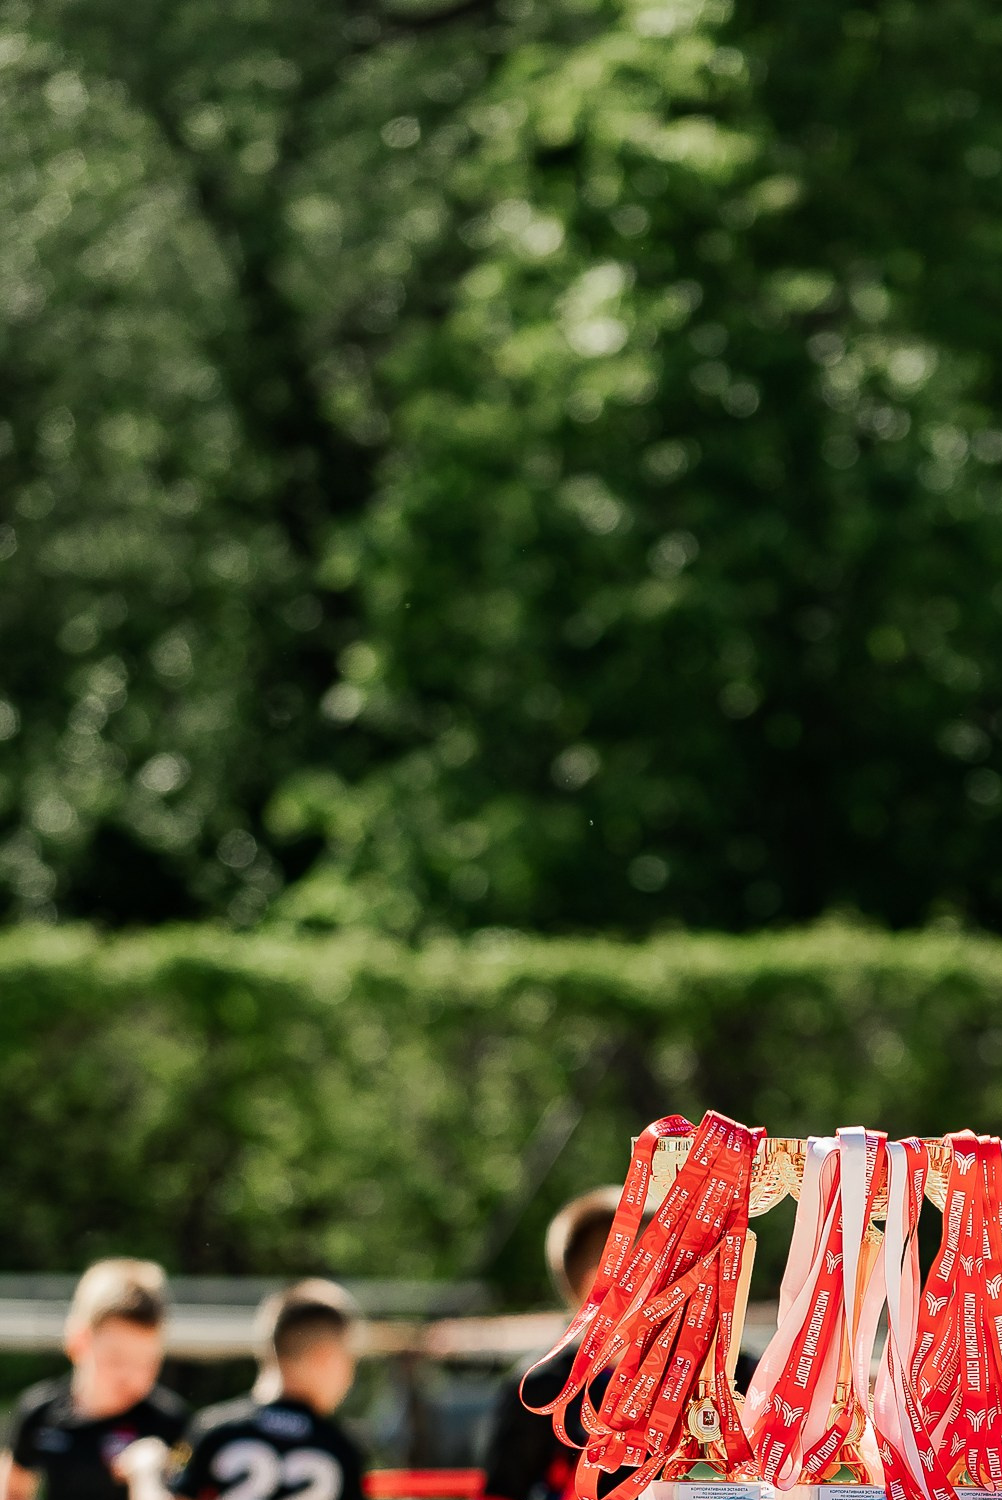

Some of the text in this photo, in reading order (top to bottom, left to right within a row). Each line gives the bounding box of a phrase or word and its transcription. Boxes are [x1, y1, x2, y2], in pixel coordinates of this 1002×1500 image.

[667, 1249, 686, 1285] ПОРТИВНАЯ
[936, 1190, 966, 1282] МОСКОВСКИЙ СПОРТ
[794, 1290, 830, 1390] МОСКОВСКИЙ СПОРТ
[964, 1292, 981, 1393] МОСКОВСКИЙ СПОРТ
[986, 1447, 1001, 1478] СПОРТ
